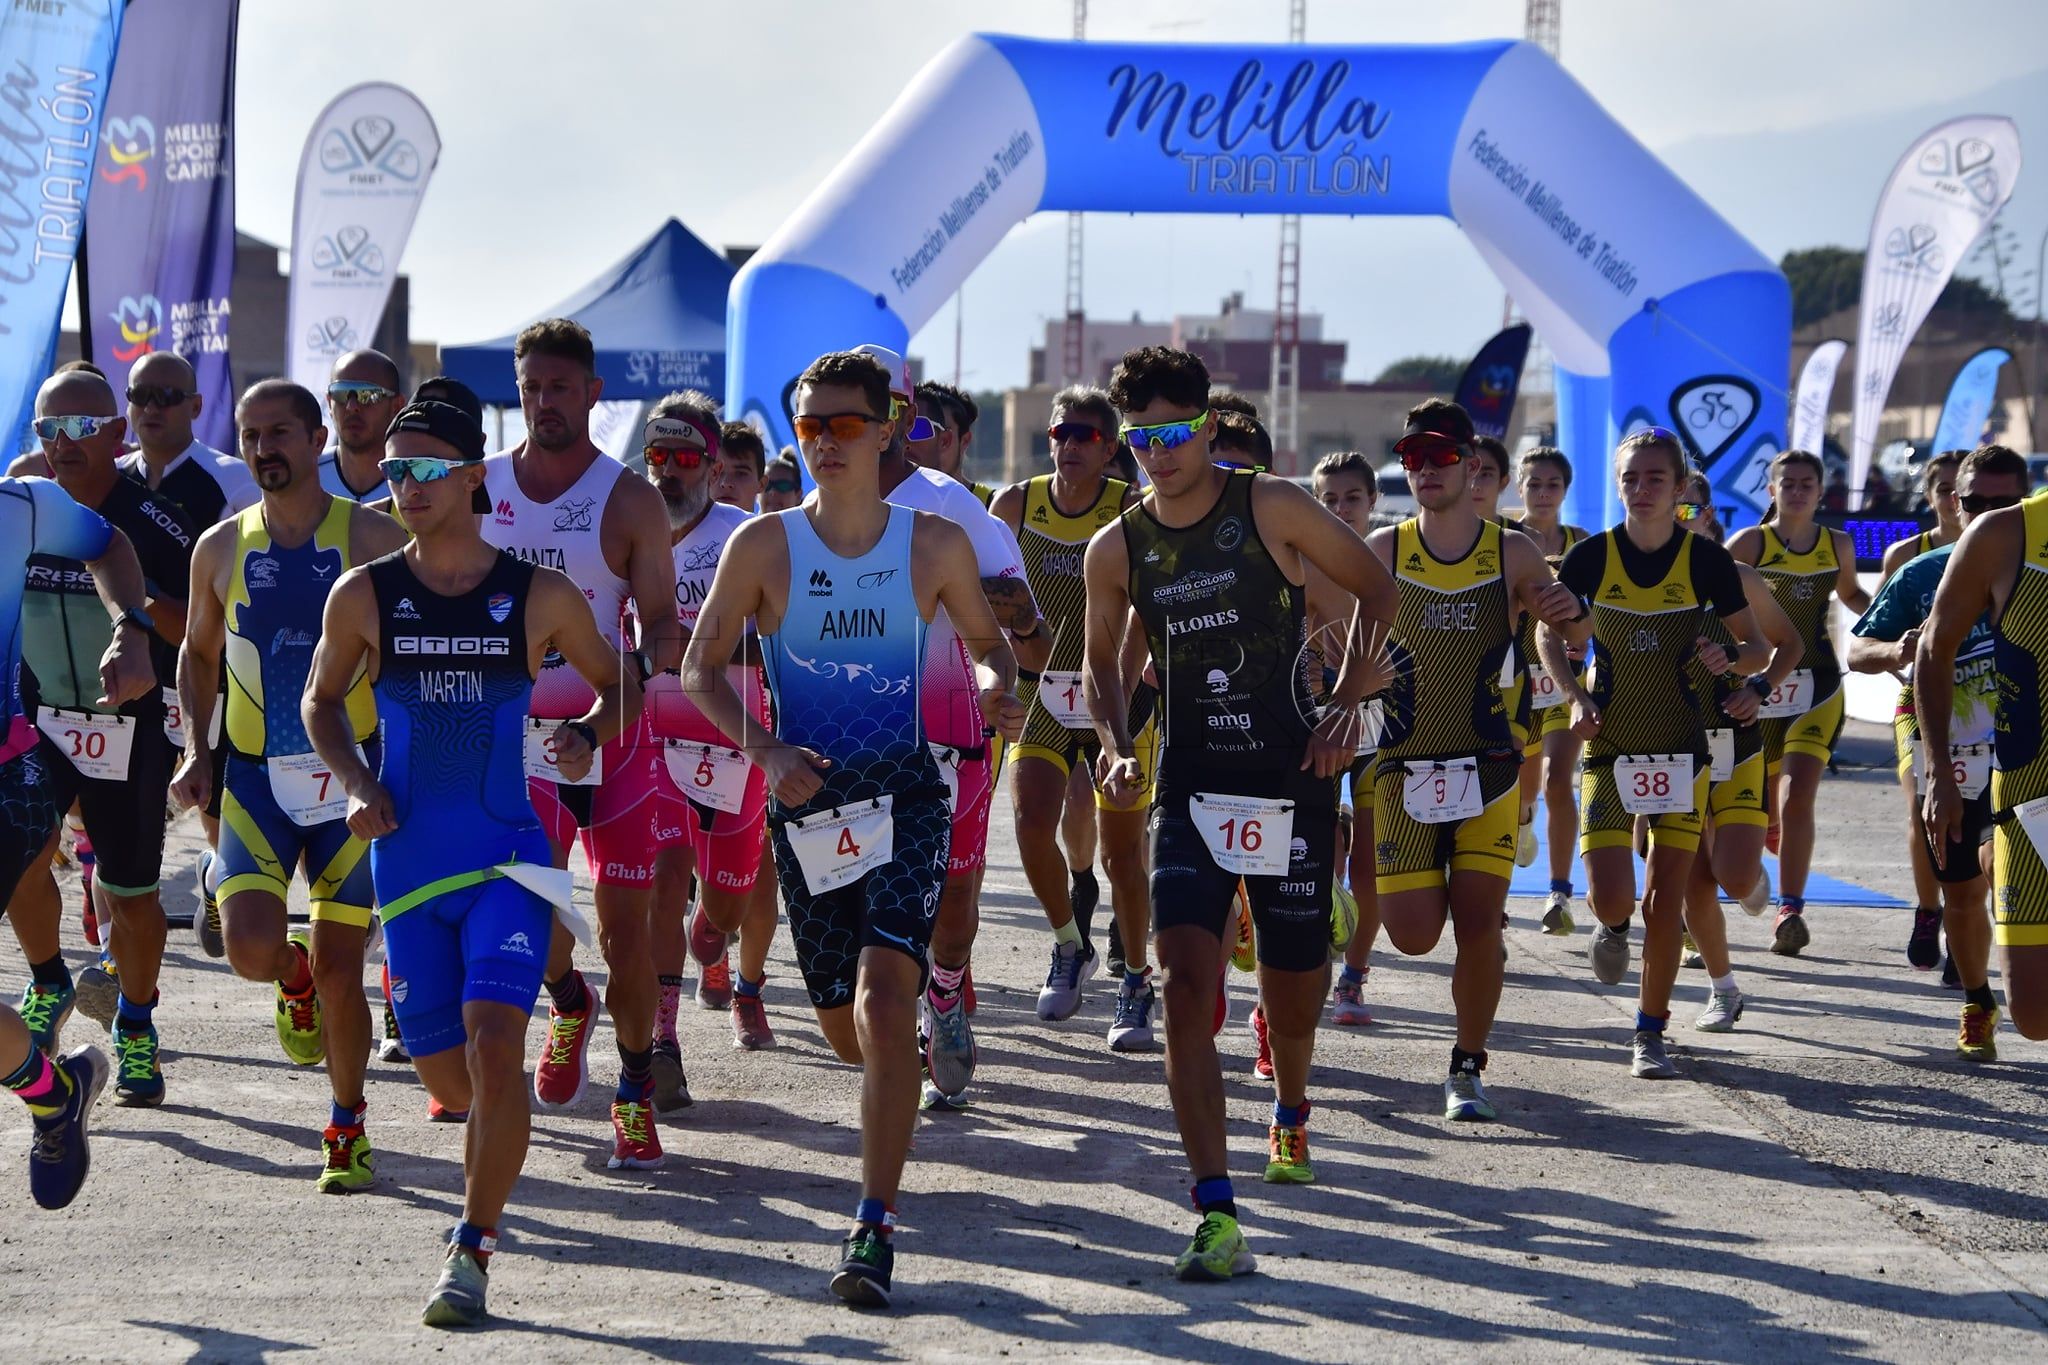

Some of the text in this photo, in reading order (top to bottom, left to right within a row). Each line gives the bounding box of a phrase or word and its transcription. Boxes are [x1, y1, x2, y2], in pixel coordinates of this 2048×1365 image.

[1105, 59, 1390, 157] Melilla
[165, 143, 221, 161] SPORT
[34, 66, 98, 266] TRIATLÓN
[984, 166, 1002, 192] de
[1181, 140, 1390, 195] TRIATLÓN
[1576, 232, 1597, 260] de
[658, 351, 710, 363] MELILLA
[658, 363, 699, 375] SPORT
[657, 374, 711, 388] CAPITAL
[655, 425, 693, 438] Gracias
[1042, 551, 1085, 578] MANOL
[27, 578, 57, 588] TORY
[809, 589, 833, 597] mobel
[1153, 570, 1236, 598] CORTIJO COLOMO
[819, 607, 886, 641] AMIN
[1168, 608, 1240, 636] FLORES
[1421, 602, 1478, 631] JIMENEZ
[420, 671, 483, 703] MARTIN
[1207, 713, 1252, 729] amg
[64, 729, 106, 759] 30
[693, 761, 715, 787] 5
[1633, 771, 1671, 797] 38
[1952, 760, 1968, 785] 6
[311, 771, 332, 802] 7
[1434, 778, 1446, 804] 9
[836, 826, 861, 857] 4
[1218, 817, 1263, 852] 16
[605, 861, 647, 881] Club
[716, 869, 752, 887] Club
[1278, 880, 1316, 896] amg
